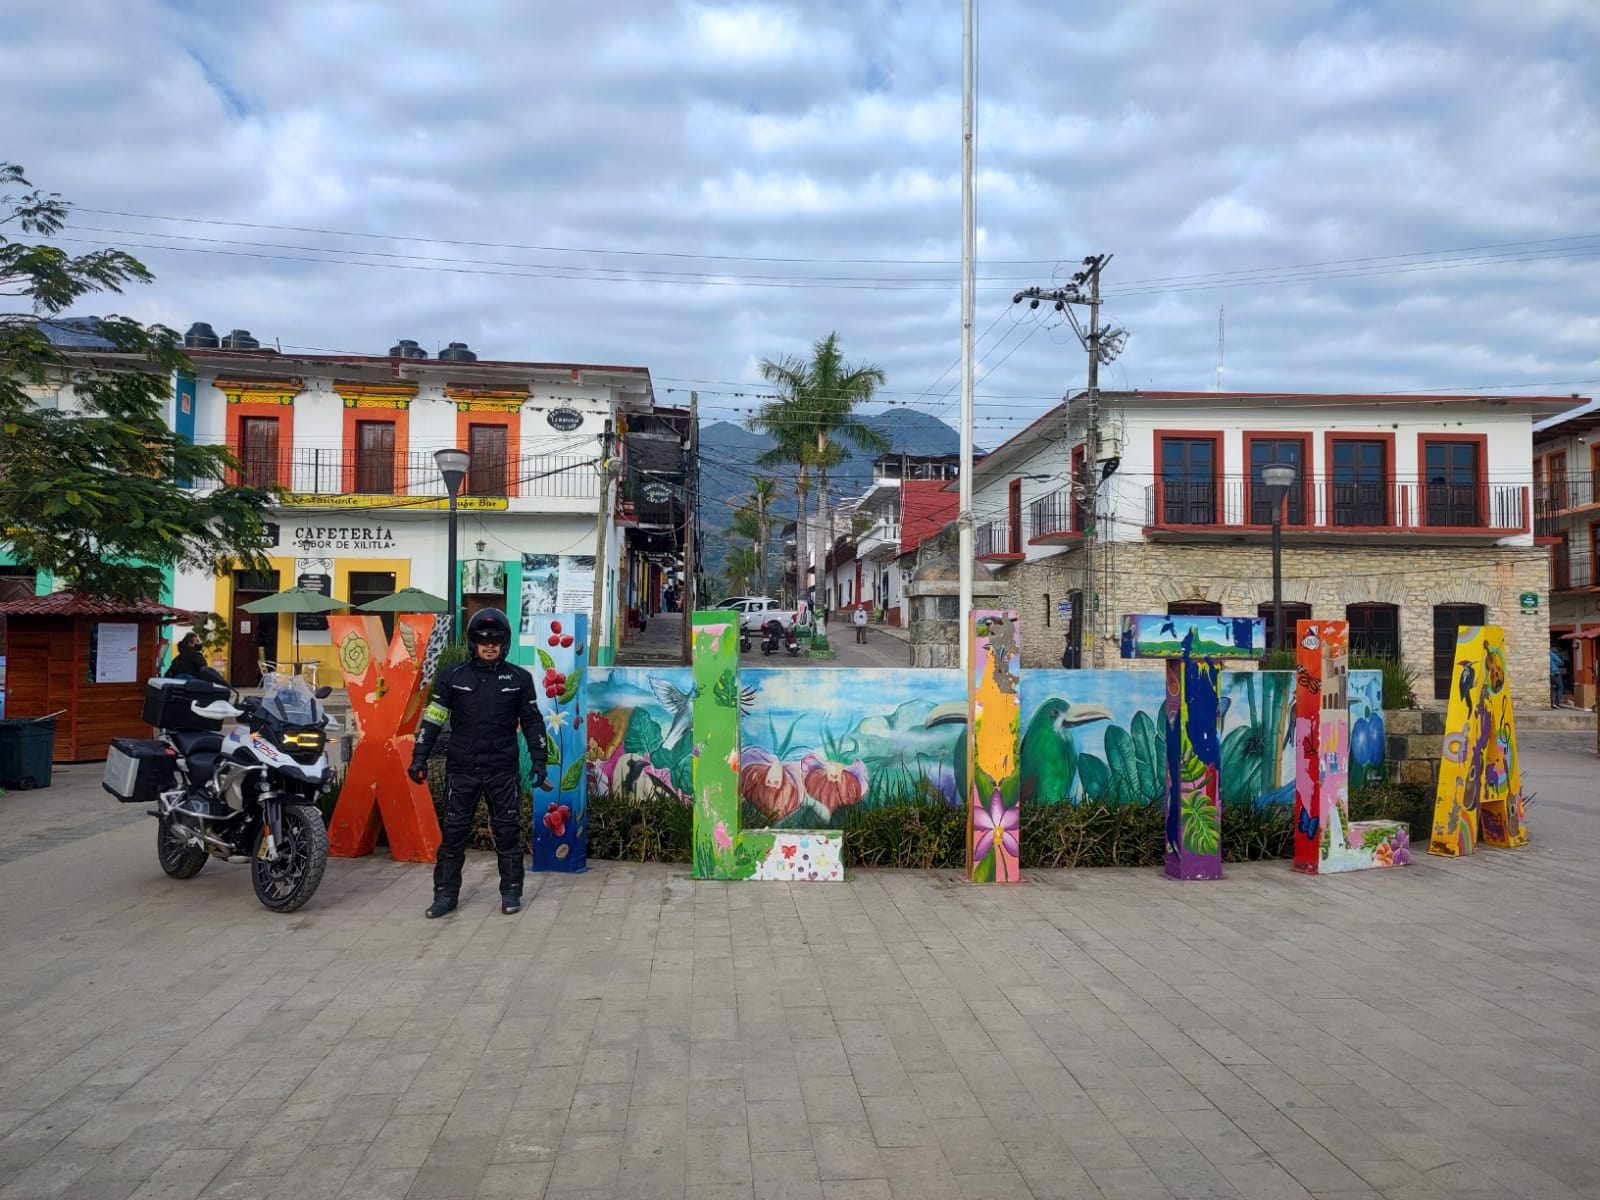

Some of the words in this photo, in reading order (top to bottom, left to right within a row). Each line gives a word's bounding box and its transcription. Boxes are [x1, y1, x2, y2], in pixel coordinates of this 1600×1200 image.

[295, 525, 393, 540] CAFETERÍA
[297, 540, 332, 549] SBOR
[336, 540, 350, 549] DE
[354, 541, 390, 549] XILITLA
